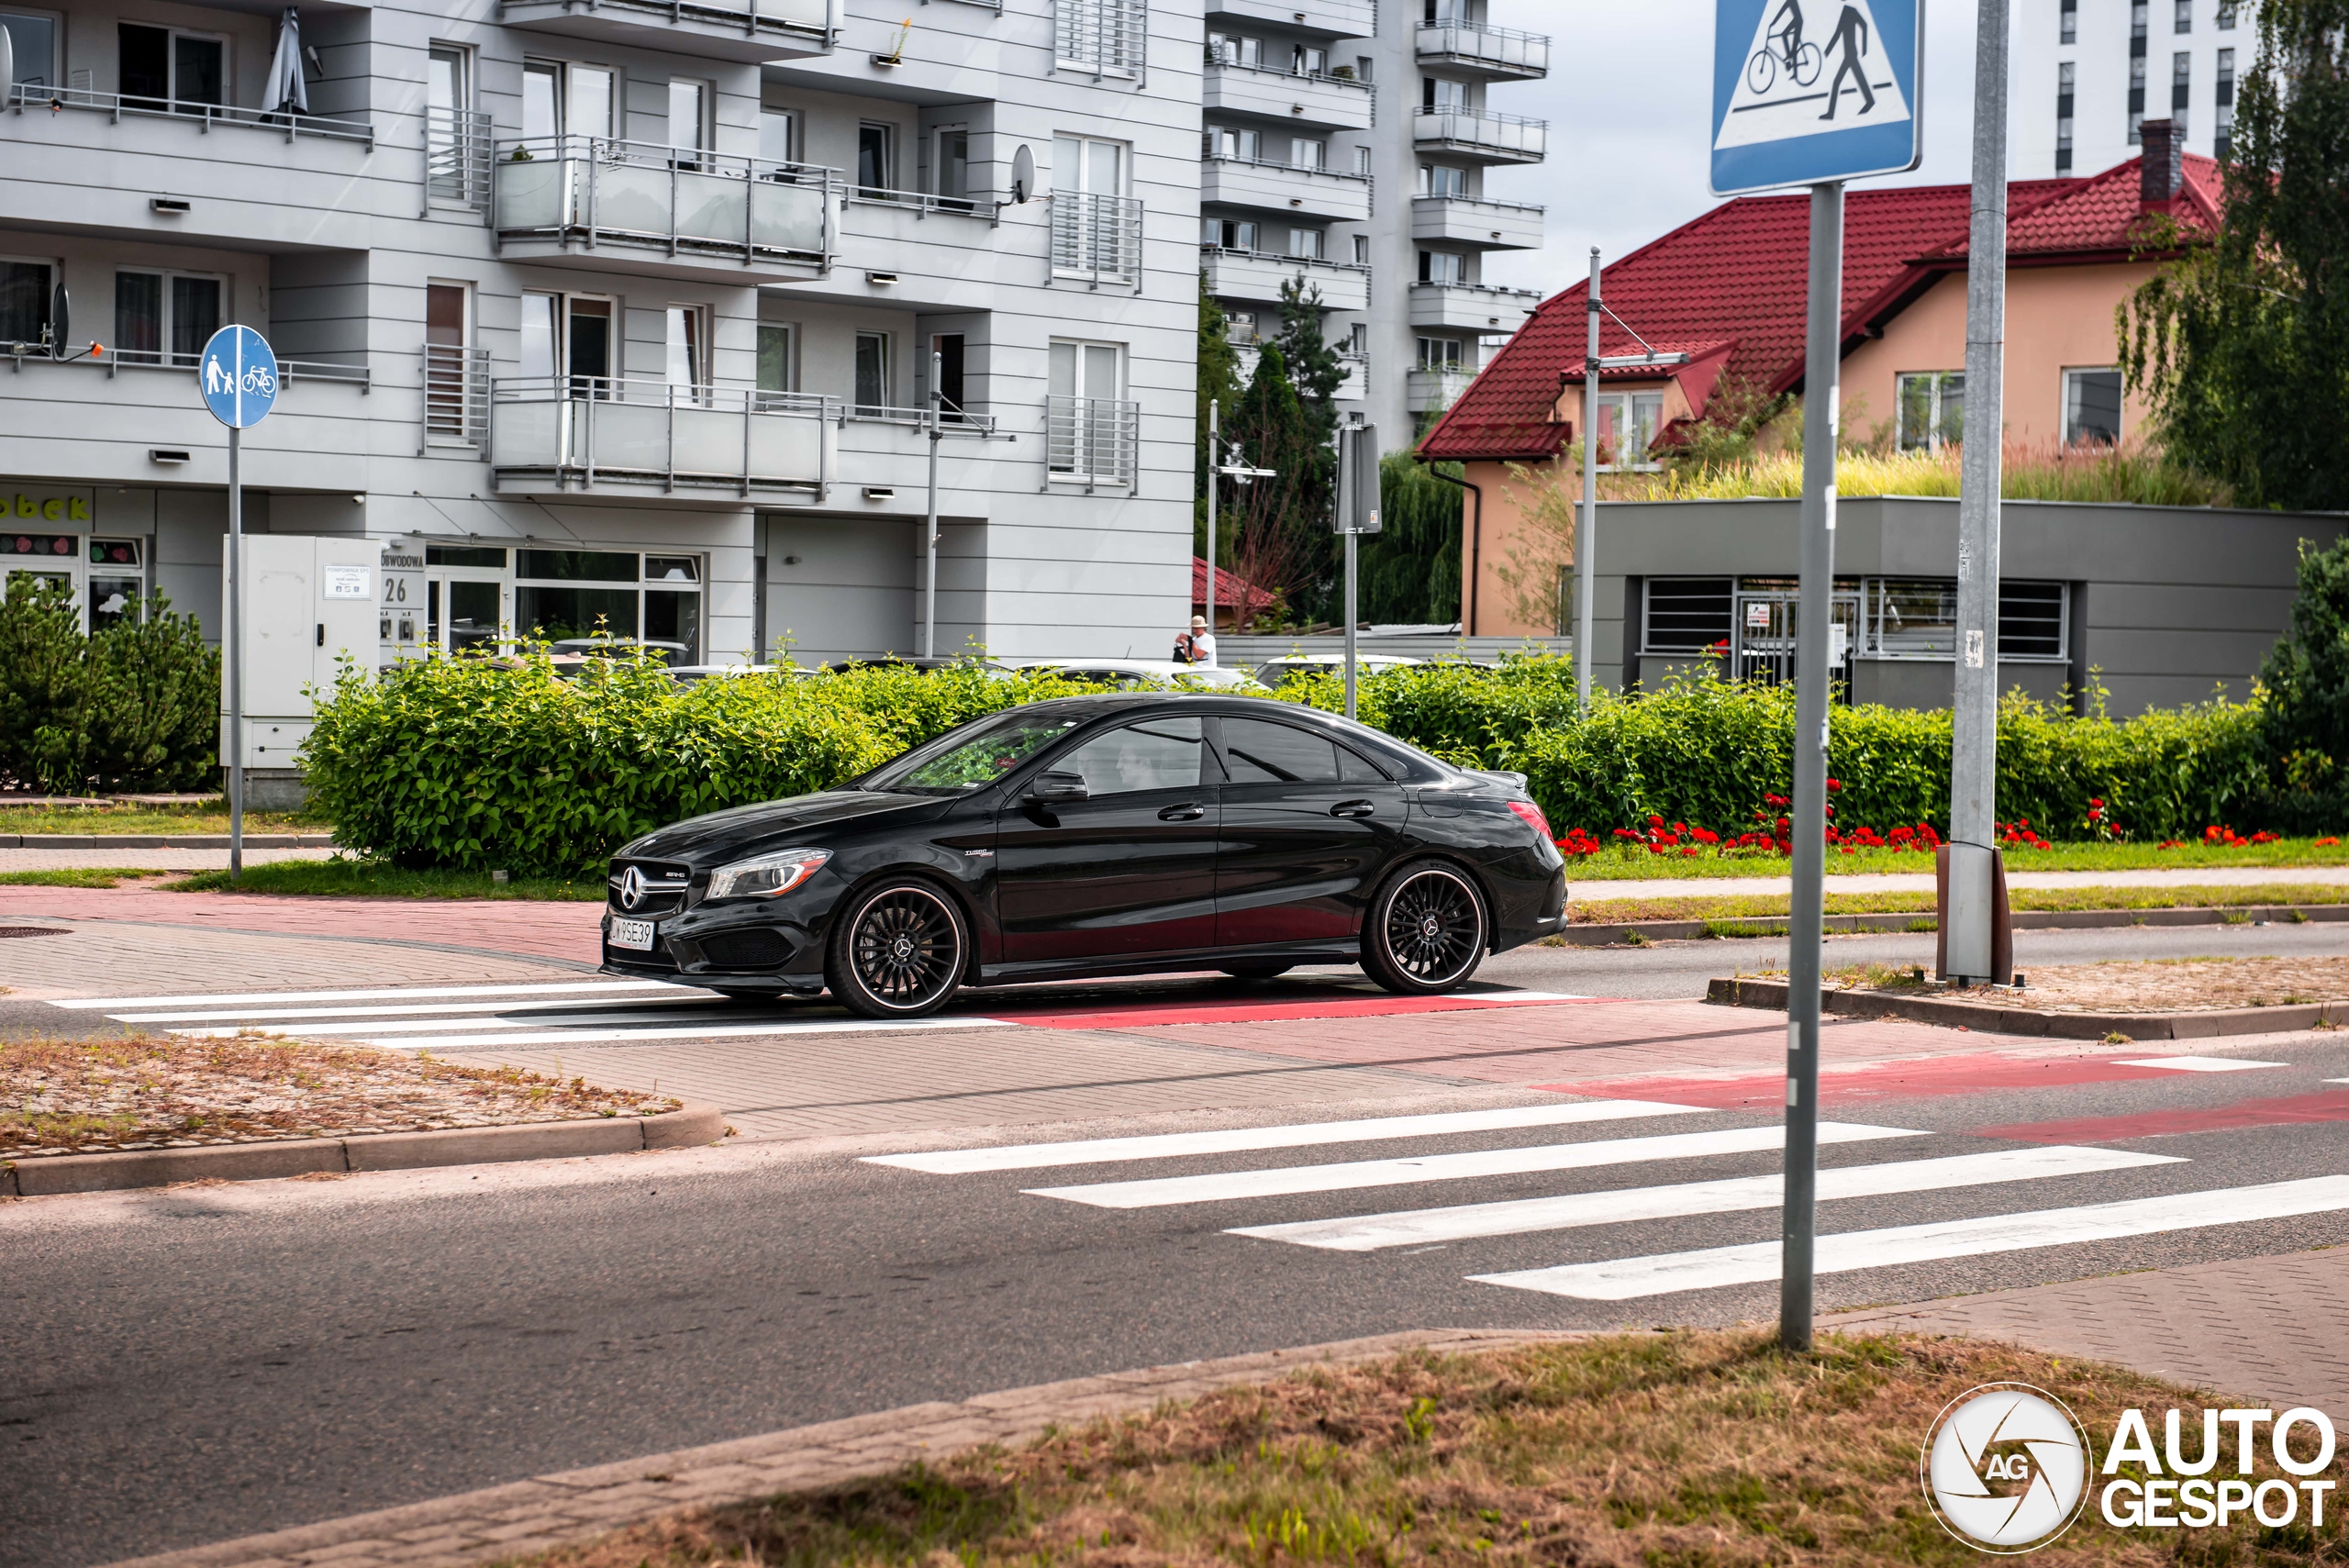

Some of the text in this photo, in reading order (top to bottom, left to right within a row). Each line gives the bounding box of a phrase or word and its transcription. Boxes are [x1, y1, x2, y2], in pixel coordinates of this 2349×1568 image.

[381, 555, 423, 567] OBWODOWA
[385, 578, 406, 602] 26
[622, 922, 651, 943] 9SE39
